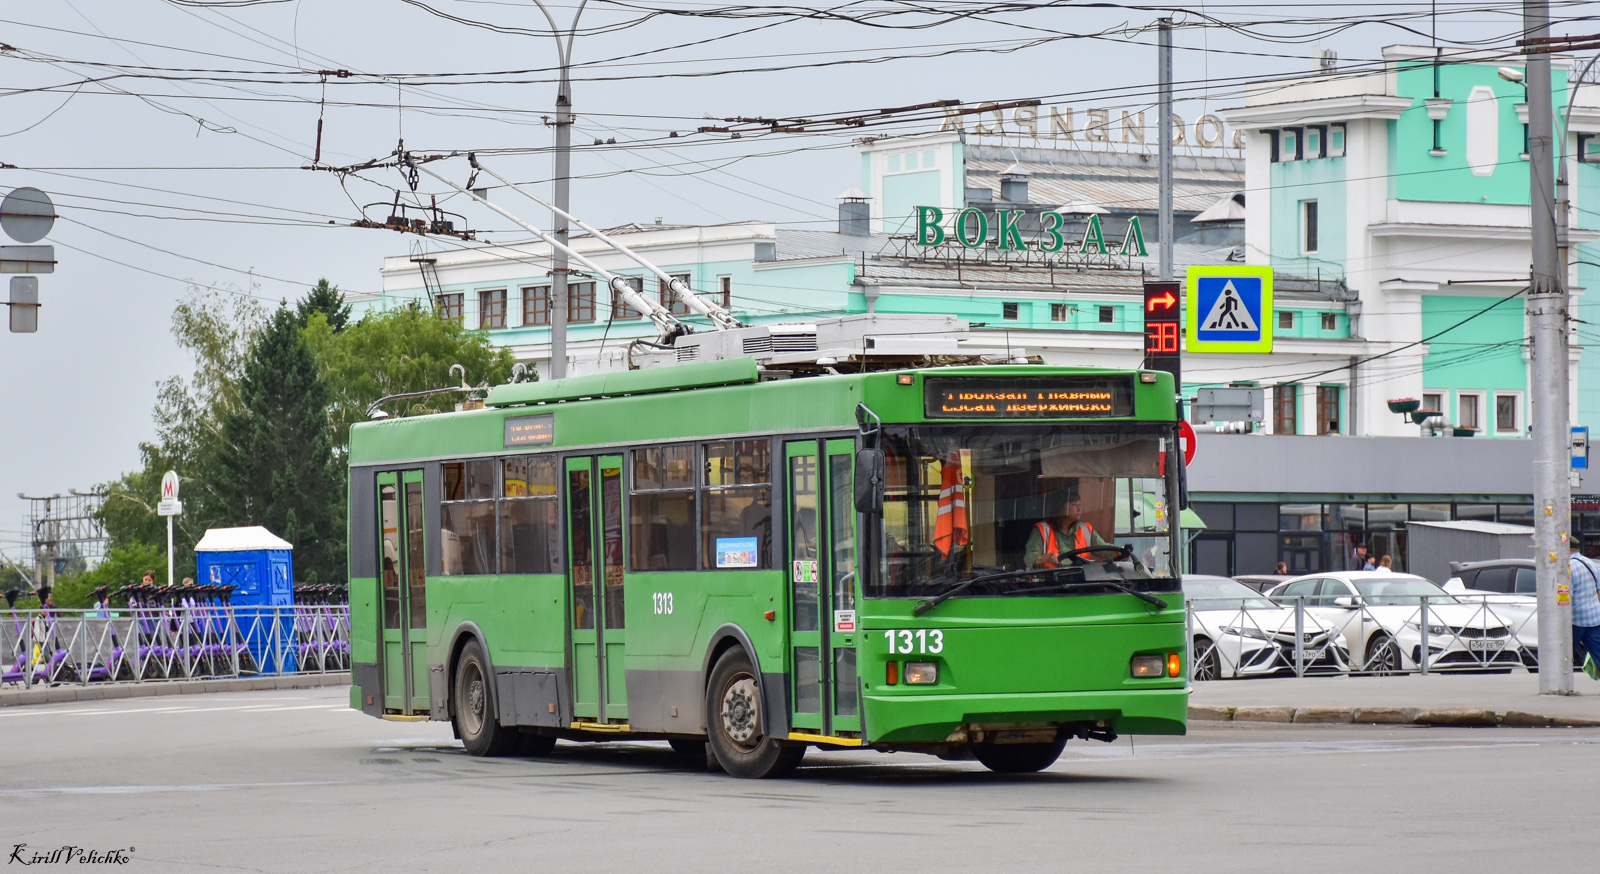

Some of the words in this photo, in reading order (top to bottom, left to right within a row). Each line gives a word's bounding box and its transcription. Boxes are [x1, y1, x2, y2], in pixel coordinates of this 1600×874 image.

[914, 205, 1149, 257] ВОКЗАЛ
[1147, 322, 1177, 352] 38
[652, 592, 675, 615] 1313
[884, 629, 944, 654] 1313
